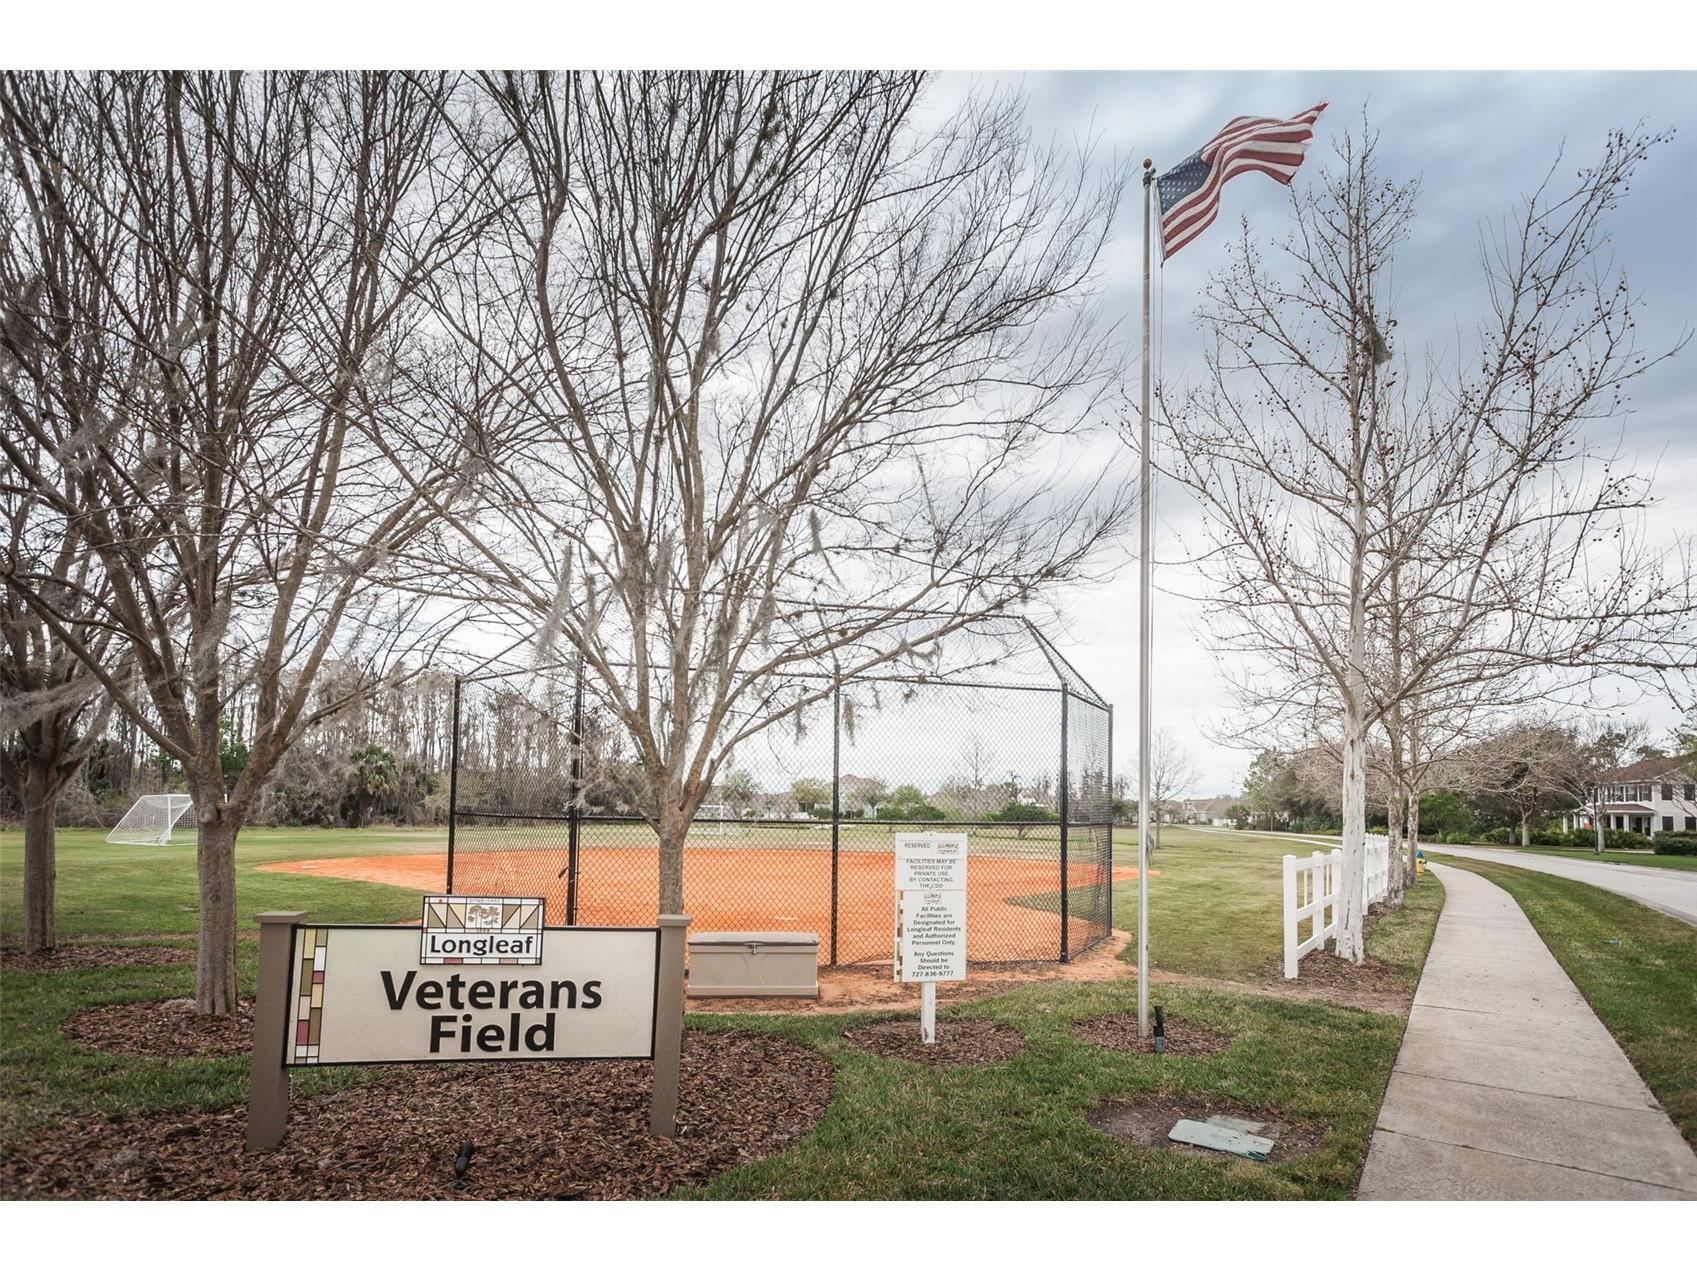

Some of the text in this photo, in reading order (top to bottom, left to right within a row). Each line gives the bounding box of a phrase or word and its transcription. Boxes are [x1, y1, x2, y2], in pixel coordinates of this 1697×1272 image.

[430, 935, 533, 956] Longleaf
[381, 970, 602, 1010] Veterans
[429, 1012, 556, 1053] Field
